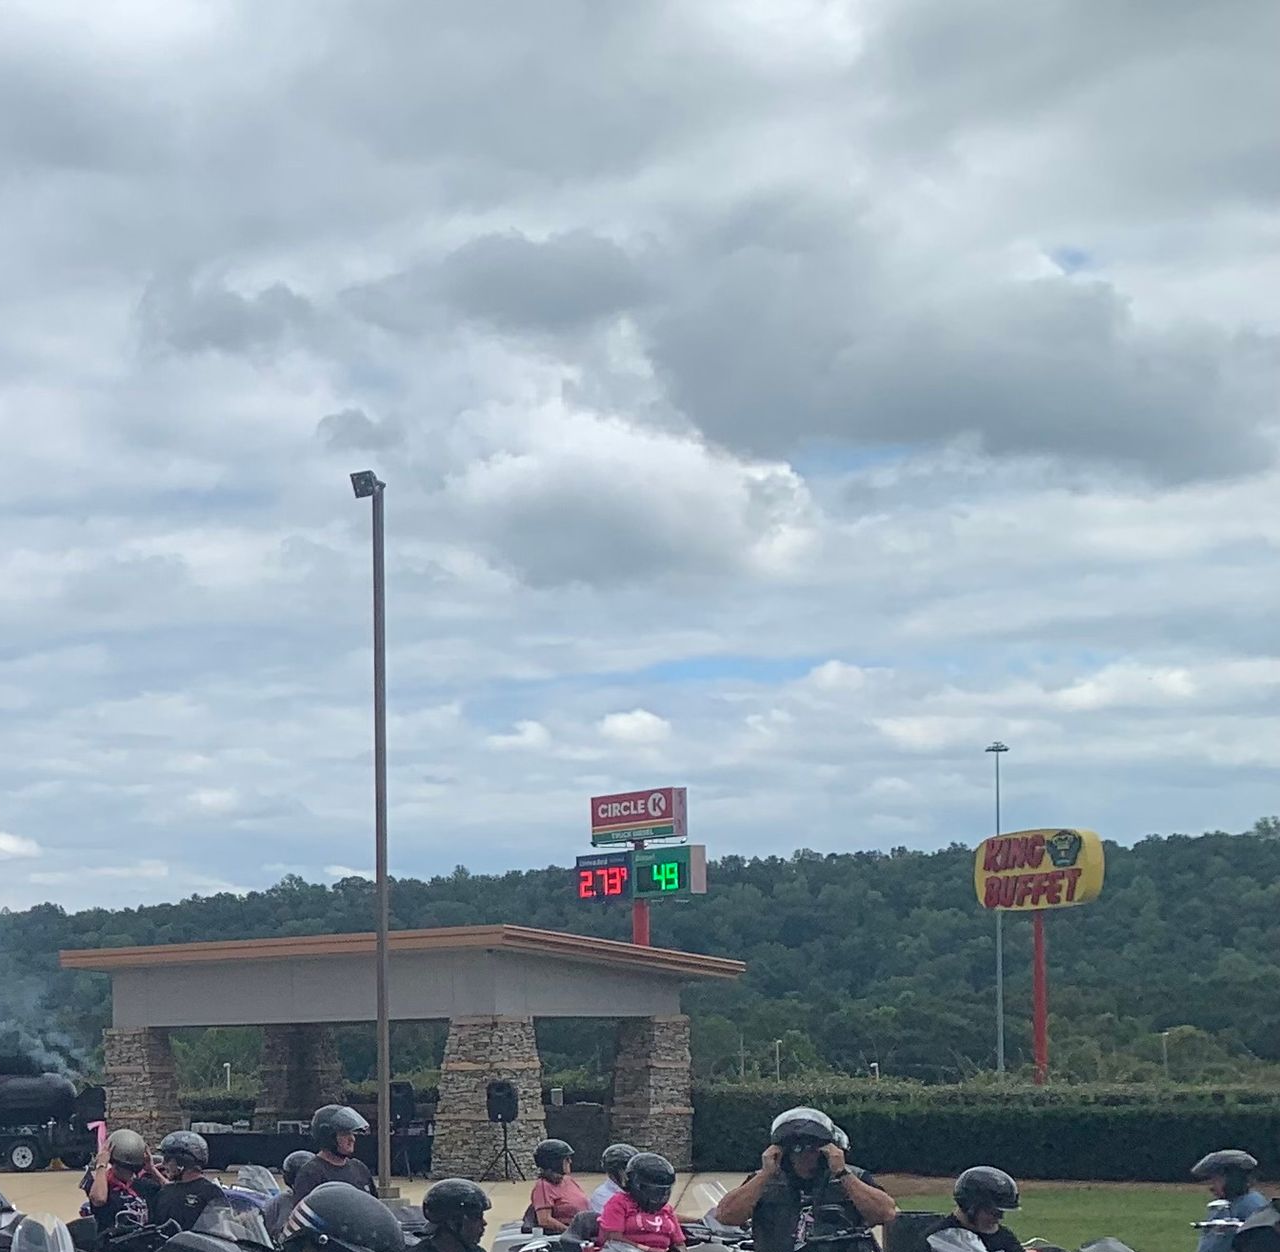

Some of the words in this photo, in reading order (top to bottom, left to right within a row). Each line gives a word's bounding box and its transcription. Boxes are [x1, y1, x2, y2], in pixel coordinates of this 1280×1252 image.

[598, 800, 645, 818] CIRCLE
[649, 794, 665, 816] K
[983, 834, 1045, 872] KING
[653, 862, 679, 890] 49
[984, 867, 1082, 909] BUFFET
